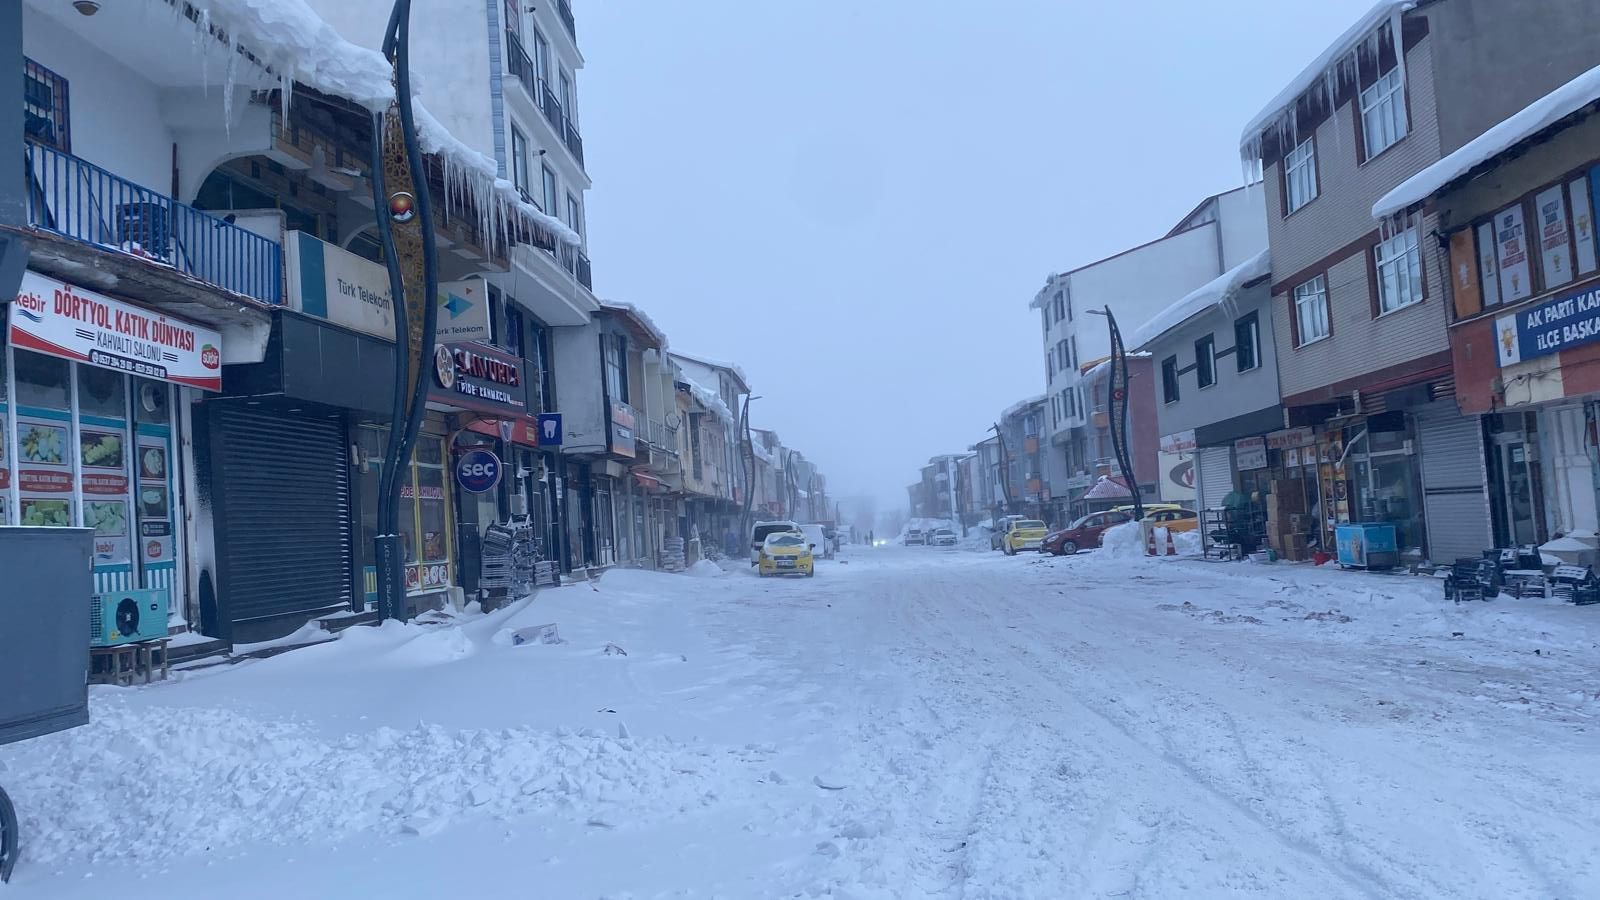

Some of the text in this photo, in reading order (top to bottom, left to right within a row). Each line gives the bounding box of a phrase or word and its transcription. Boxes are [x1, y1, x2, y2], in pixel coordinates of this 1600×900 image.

[337, 278, 390, 310] Türk Telekom
[54, 285, 194, 352] DÖRTYOL KATIK DÜNYASI
[1527, 310, 1543, 329] AK
[436, 326, 484, 335] ürk Telekom
[1537, 329, 1560, 350] İLÇE
[97, 330, 160, 361] KAHVALTI SALONU
[462, 463, 494, 477] seç
